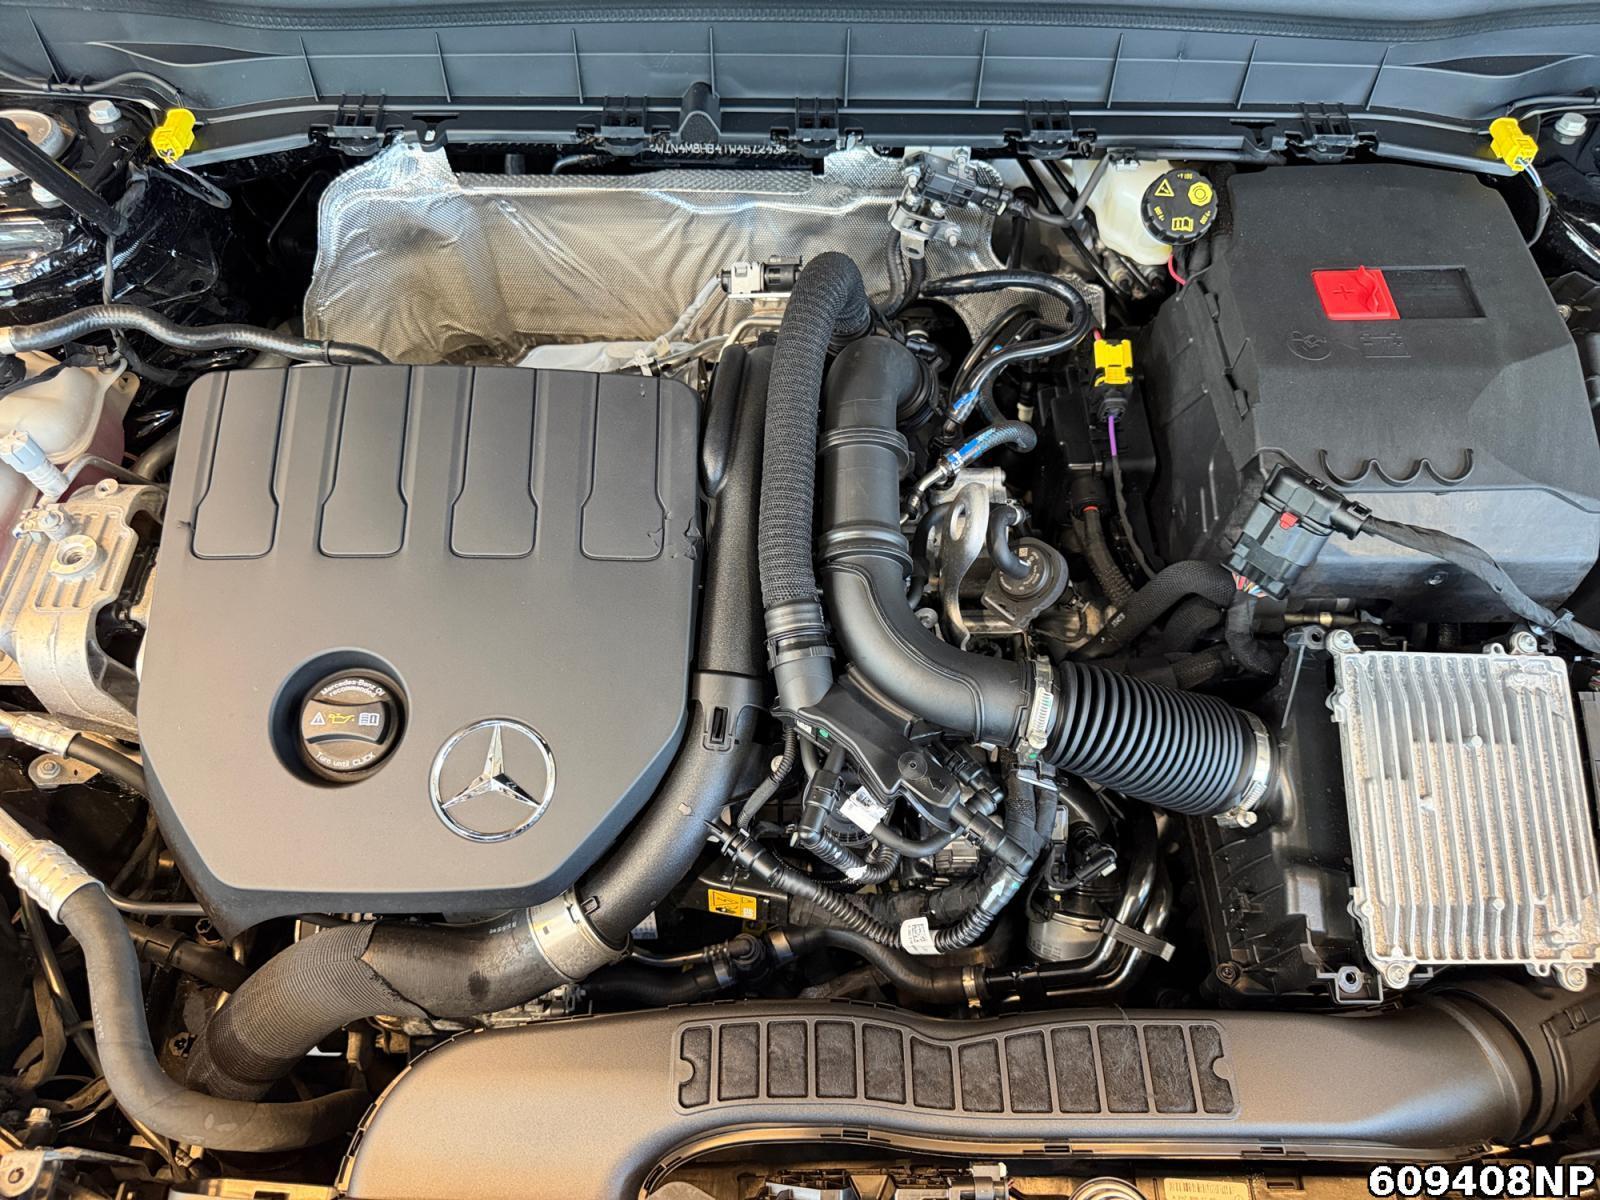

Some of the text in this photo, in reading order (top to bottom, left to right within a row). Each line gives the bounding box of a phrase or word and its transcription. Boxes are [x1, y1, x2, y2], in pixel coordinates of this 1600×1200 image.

[316, 751, 376, 767] Turn until CLICK
